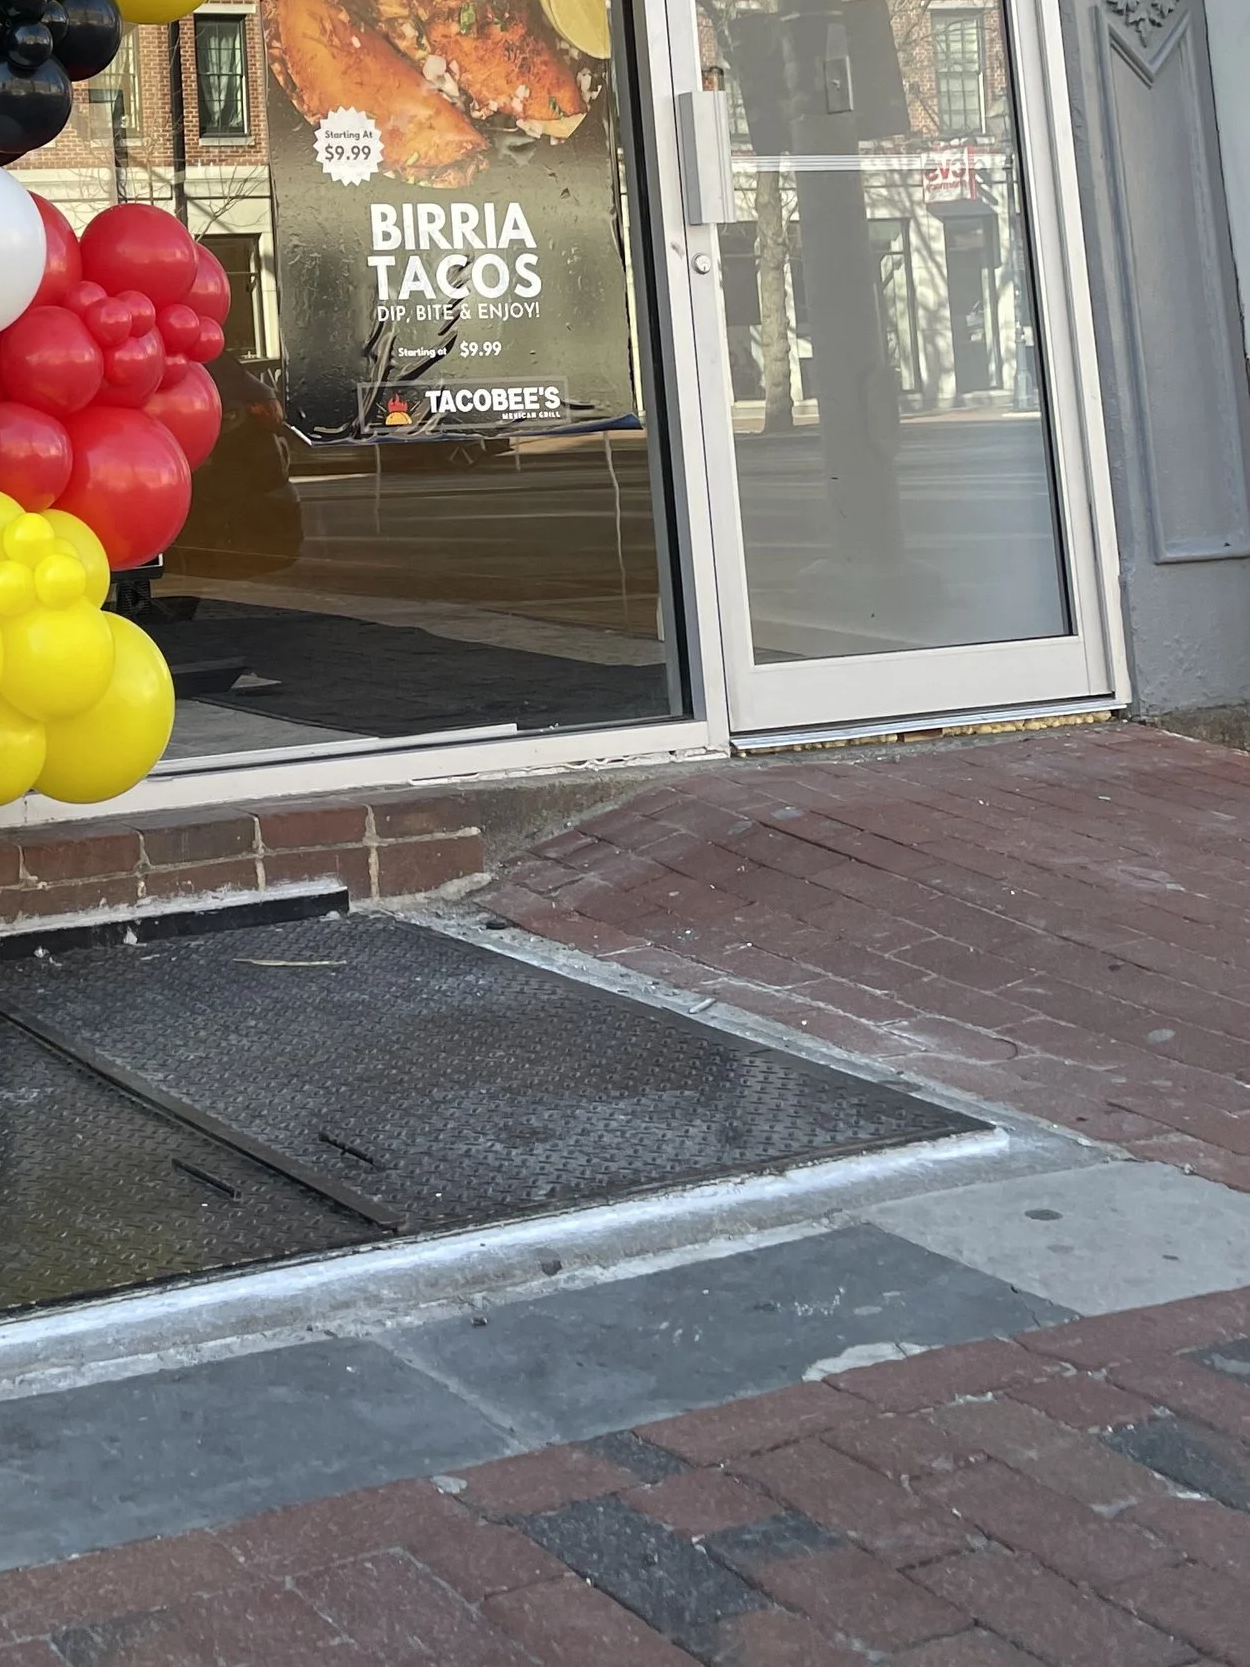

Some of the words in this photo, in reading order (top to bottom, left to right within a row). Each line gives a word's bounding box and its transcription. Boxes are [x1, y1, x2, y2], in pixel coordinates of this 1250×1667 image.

[325, 130, 360, 141] Starting
[363, 130, 373, 139] At
[325, 143, 371, 163] $9.99
[370, 202, 537, 251] BIRRIA
[367, 253, 542, 301] TACOS
[377, 305, 410, 324] DIP,
[416, 304, 455, 321] BITE
[459, 303, 472, 320] &
[478, 301, 541, 321] ENJOY!
[398, 346, 436, 358] Starting
[437, 347, 448, 356] at
[460, 340, 502, 358] $9.99
[425, 386, 562, 414] TACOBEE'S
[502, 411, 537, 420] MEXICAN
[539, 411, 561, 419] GRILL
